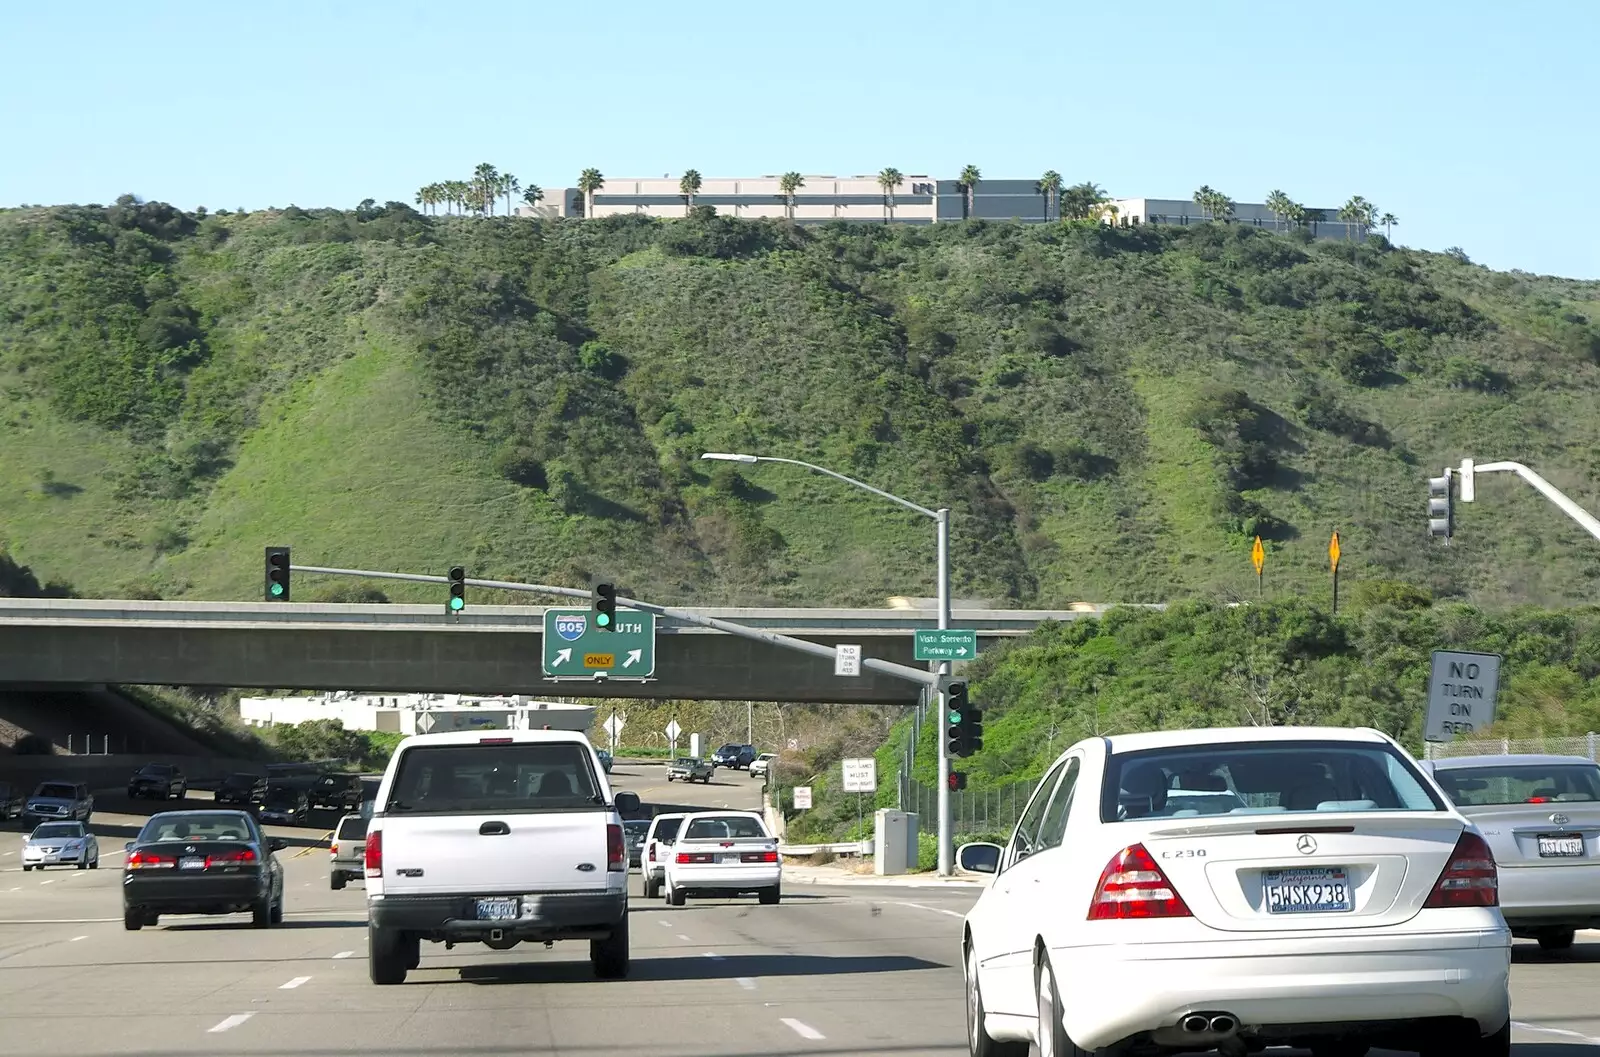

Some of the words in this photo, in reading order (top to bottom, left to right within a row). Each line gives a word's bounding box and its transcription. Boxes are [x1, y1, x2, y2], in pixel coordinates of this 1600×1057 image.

[559, 622, 583, 632] 805
[603, 623, 642, 633] UTH
[919, 635, 937, 643] Vista
[940, 634, 972, 643] Sorrento
[923, 646, 953, 656] Parkway
[587, 656, 612, 665] ONLY
[1448, 661, 1480, 680] NO
[1441, 683, 1484, 699] TURN
[1449, 702, 1472, 717] ON
[1162, 851, 1171, 859] C
[1175, 848, 1207, 858] 230
[1271, 883, 1345, 906] 5WSK938
